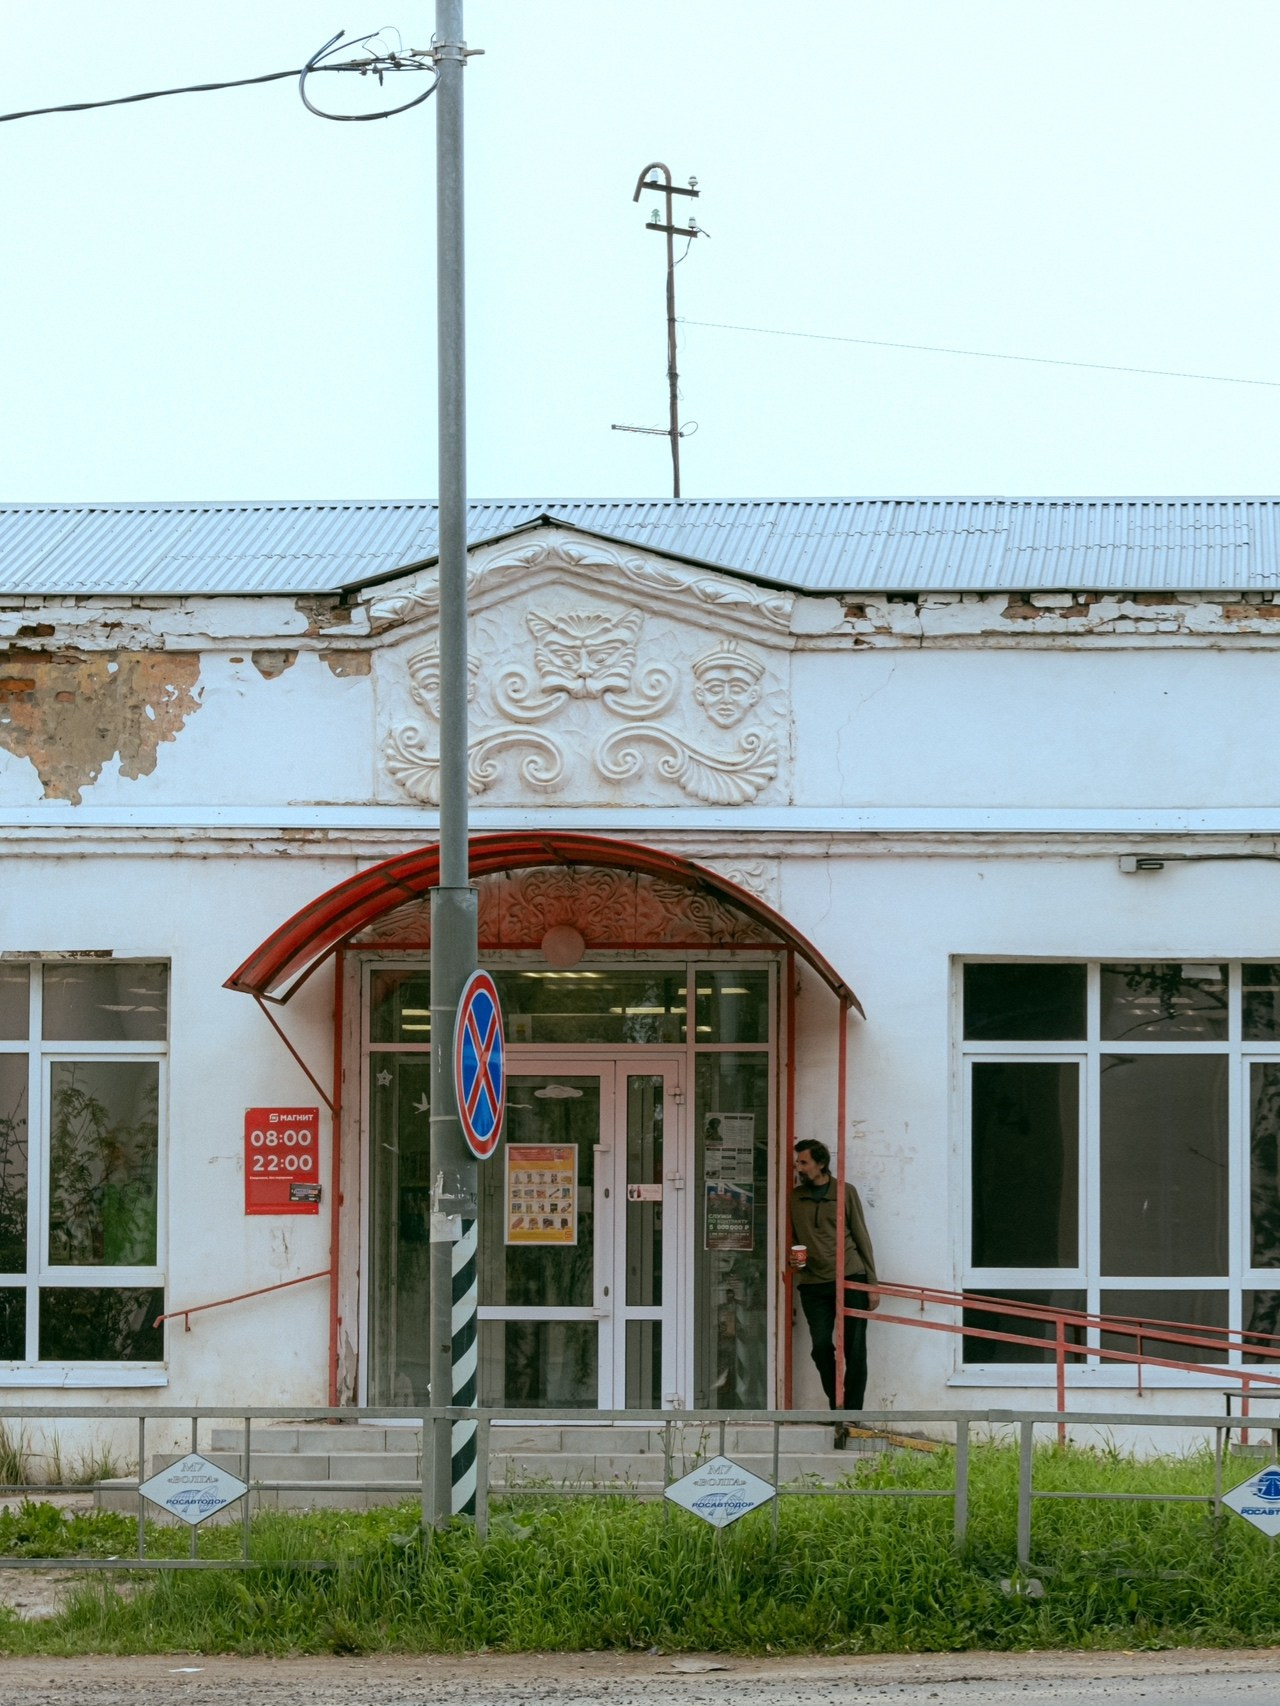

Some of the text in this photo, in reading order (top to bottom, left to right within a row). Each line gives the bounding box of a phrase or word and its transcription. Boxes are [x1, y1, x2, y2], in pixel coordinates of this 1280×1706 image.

[250, 1129, 312, 1147] 08:00
[252, 1154, 313, 1171] 22:00
[181, 1462, 206, 1472] М7
[707, 1464, 733, 1475] М7
[167, 1475, 219, 1484] «ВОЛГА»
[693, 1478, 747, 1487] «ВОЛГА»
